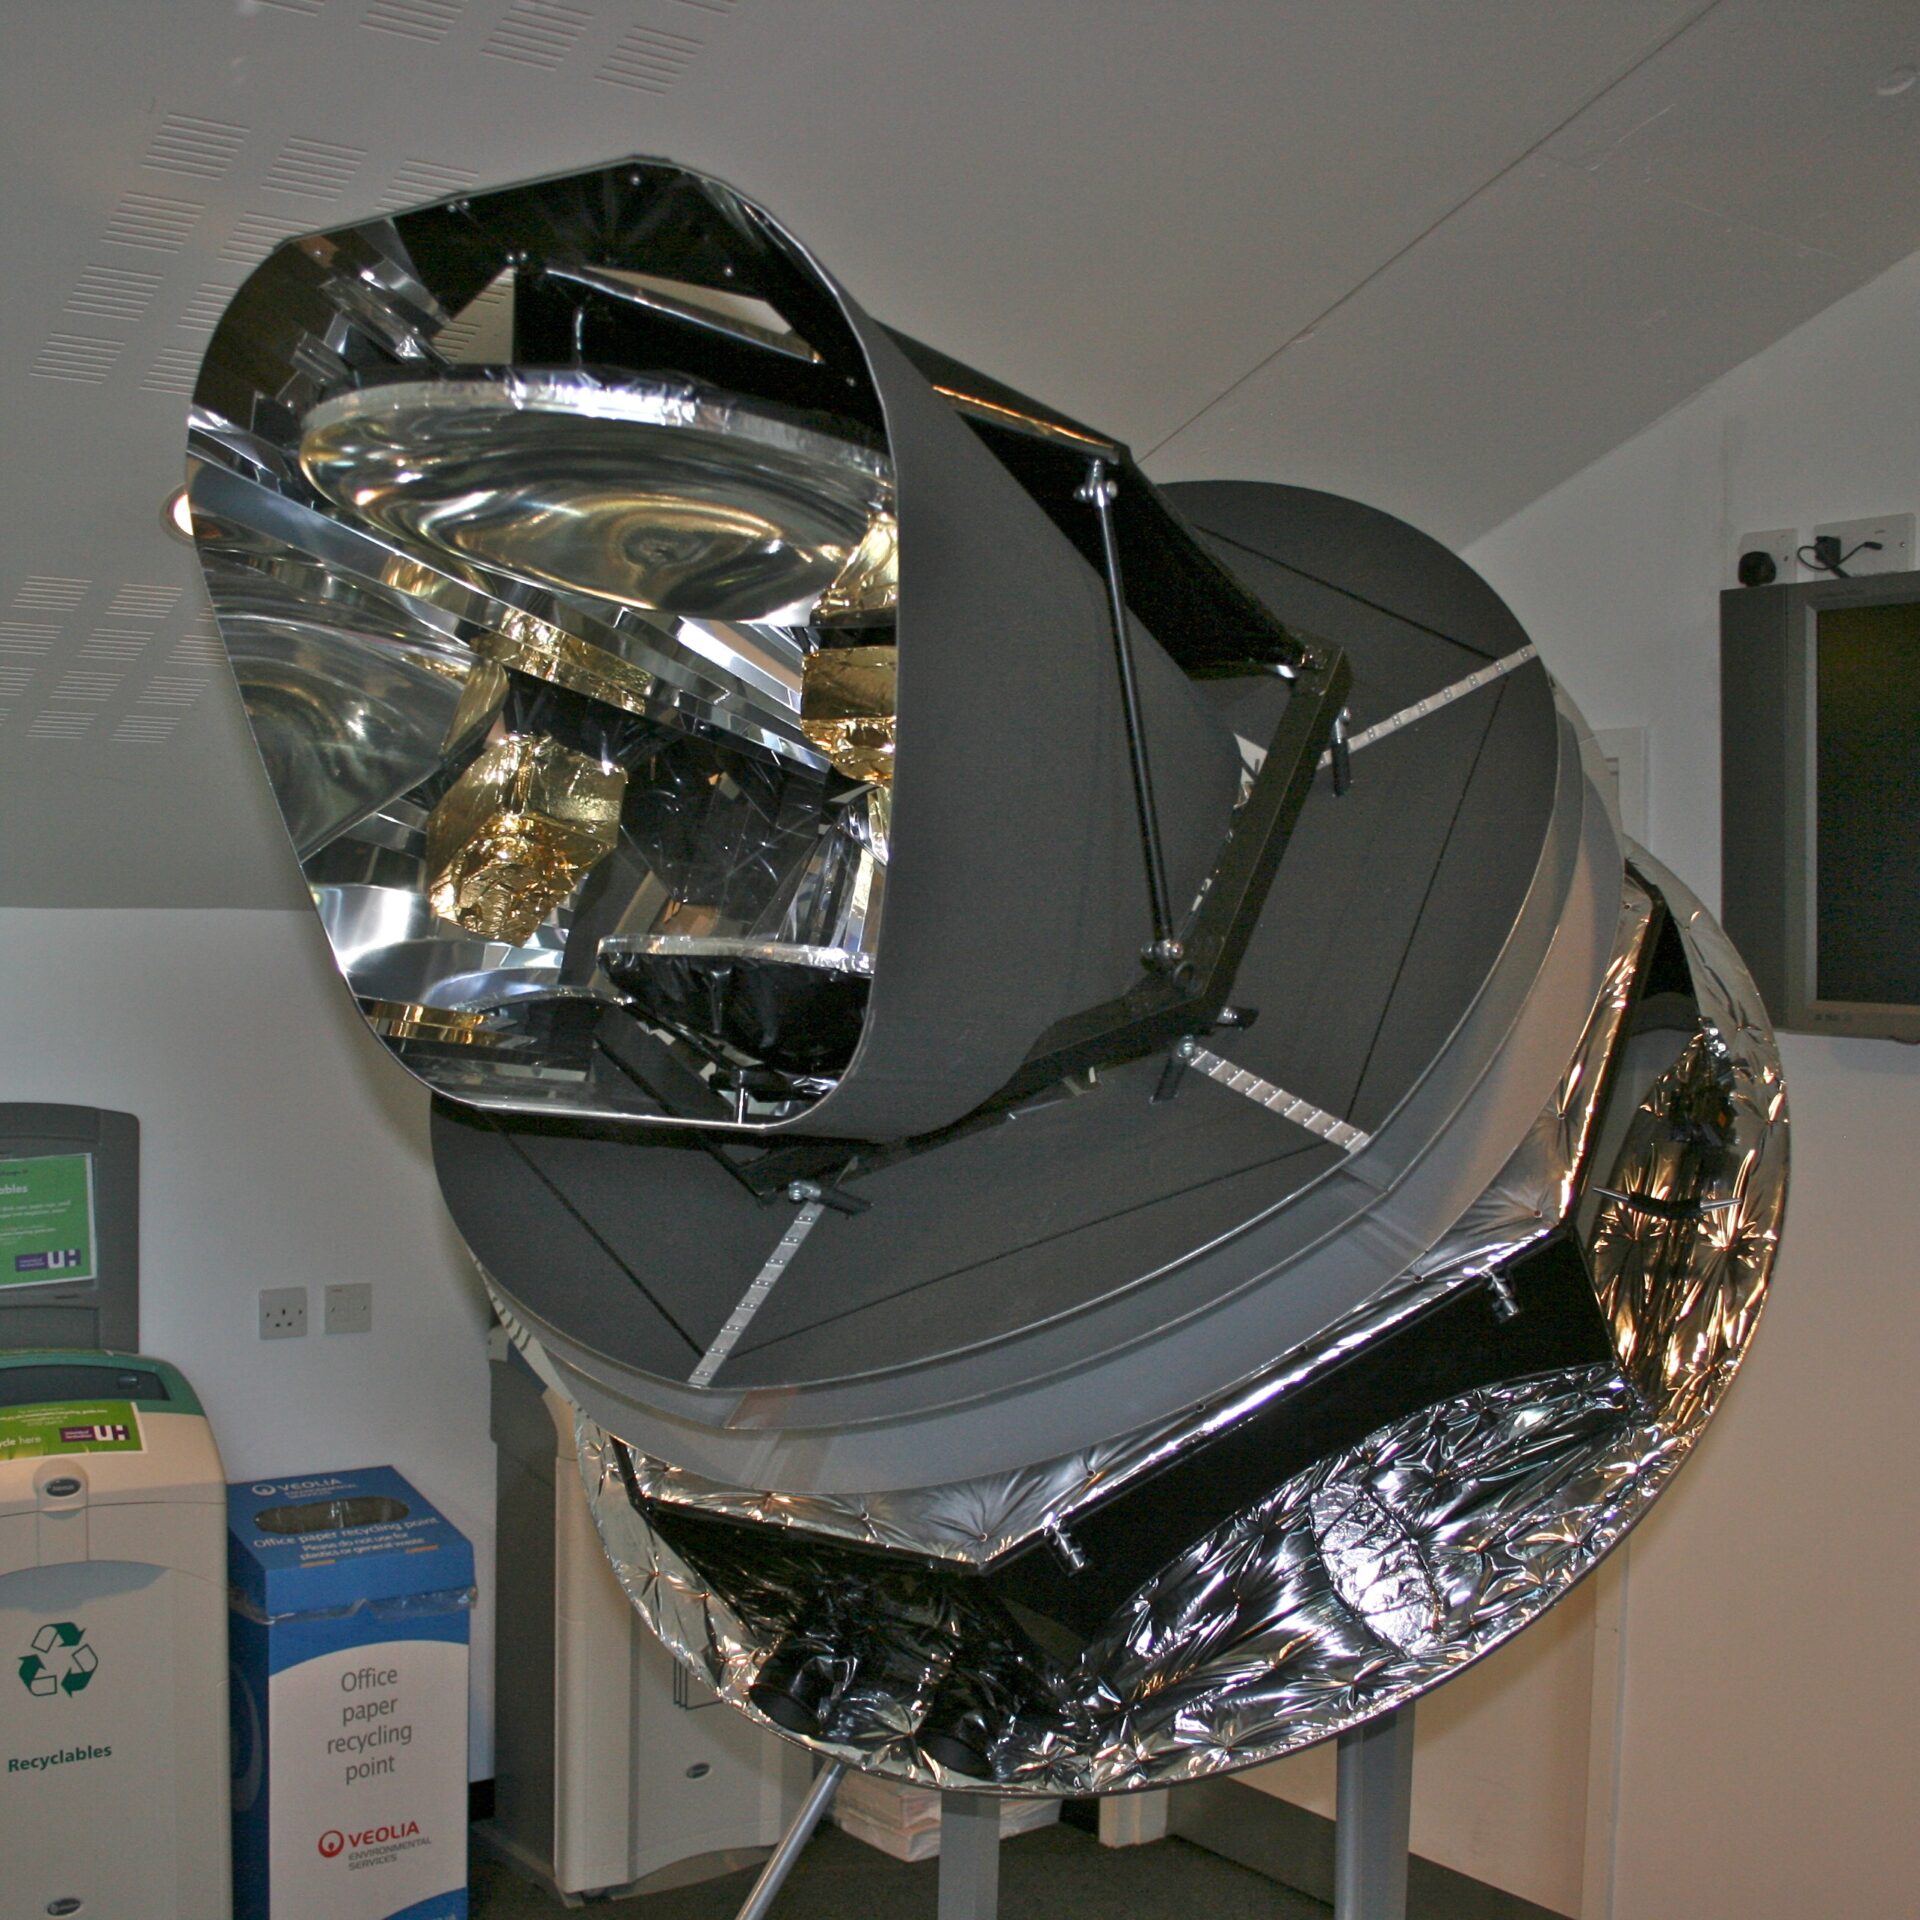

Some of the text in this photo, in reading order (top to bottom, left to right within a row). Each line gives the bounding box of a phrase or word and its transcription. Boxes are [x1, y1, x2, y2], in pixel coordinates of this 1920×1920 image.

[277, 1478, 342, 1491] VEOLIA
[253, 1517, 439, 1548] Office paper recycling point
[341, 1667, 398, 1692] Office
[342, 1697, 399, 1727] paper
[327, 1724, 413, 1754] recycling
[8, 1745, 112, 1772] Recyclables
[345, 1755, 395, 1785] point
[348, 1820, 420, 1848] VEOLIA
[348, 1837, 431, 1861] ENVIRONMENTAL
[348, 1853, 397, 1871] SERVICES
